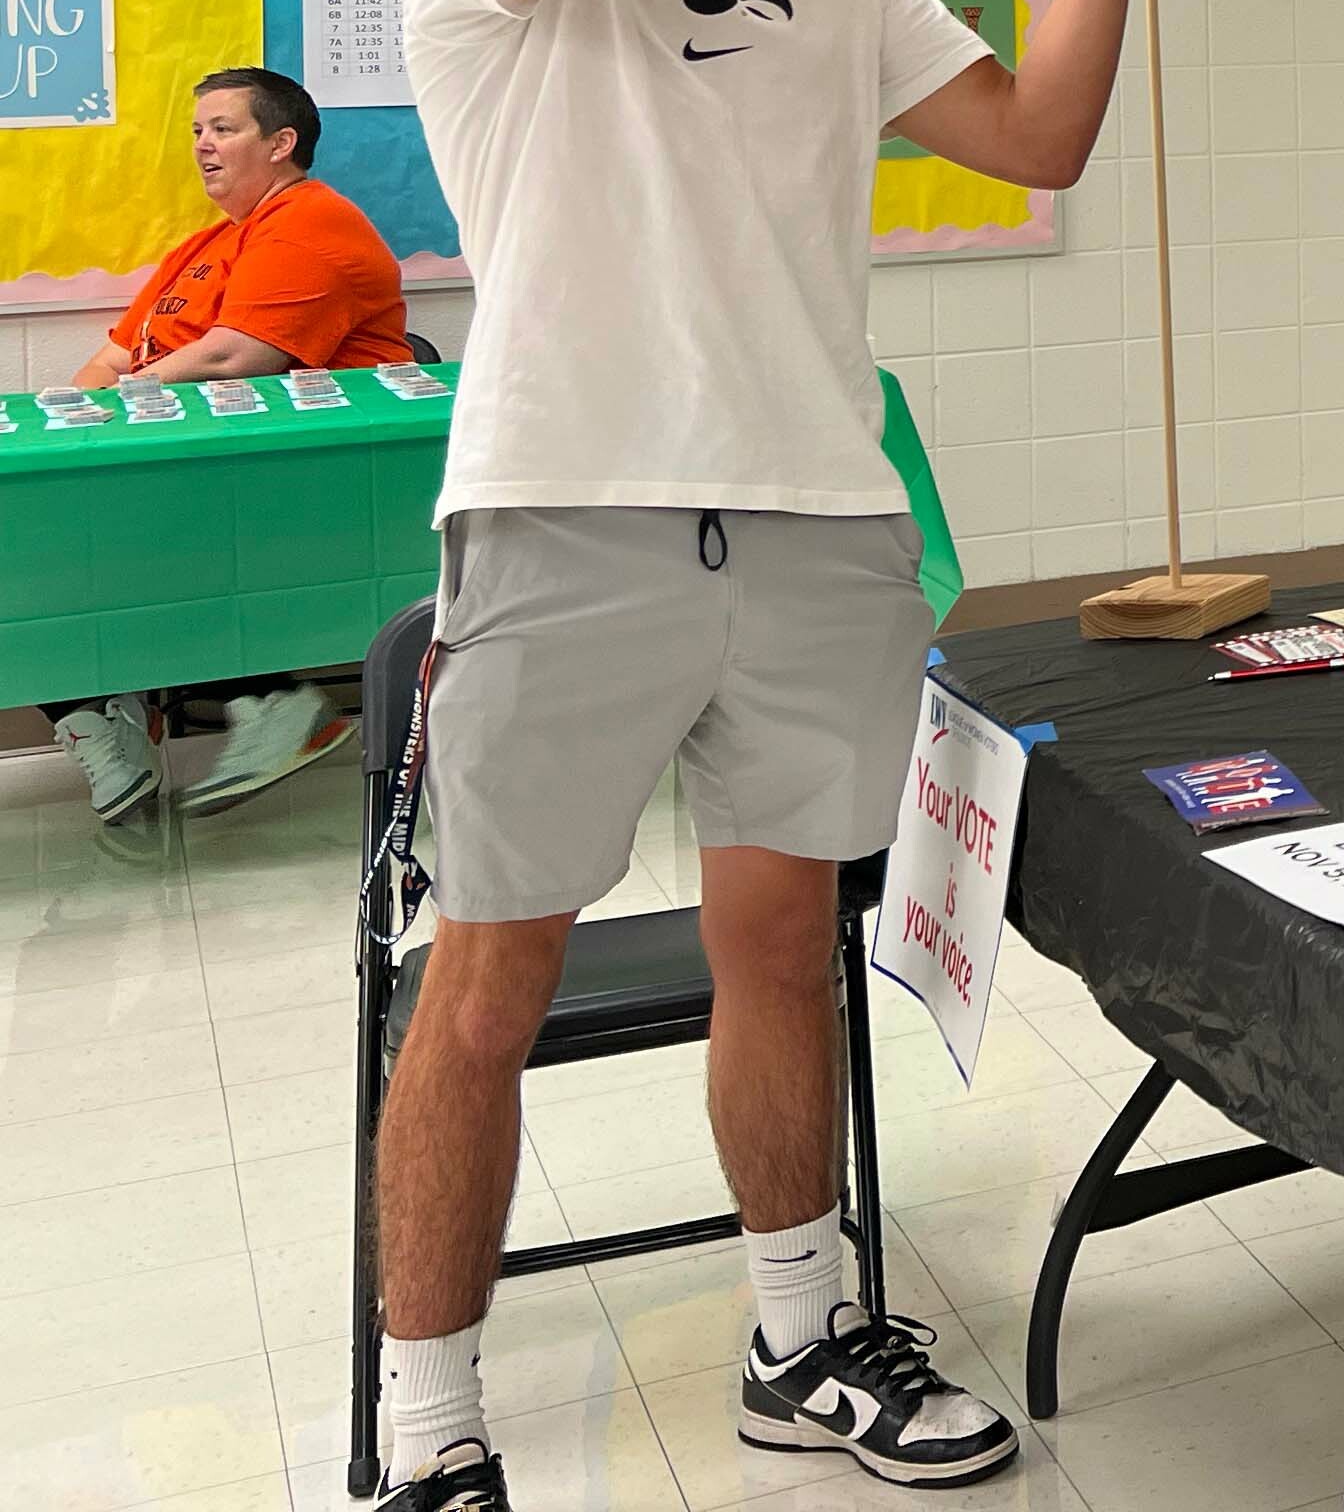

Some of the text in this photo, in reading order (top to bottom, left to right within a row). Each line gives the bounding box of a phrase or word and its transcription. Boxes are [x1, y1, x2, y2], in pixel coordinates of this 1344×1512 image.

[328, 10, 341, 19] 6B
[332, 24, 338, 33] 7
[329, 37, 342, 46] 7A
[330, 51, 342, 60] 7B
[333, 65, 339, 74] 8
[916, 756, 997, 875] Your VOTE
[391, 823, 409, 856] MID
[1273, 841, 1338, 868] NOV
[945, 862, 957, 919] is
[903, 894, 941, 957] your
